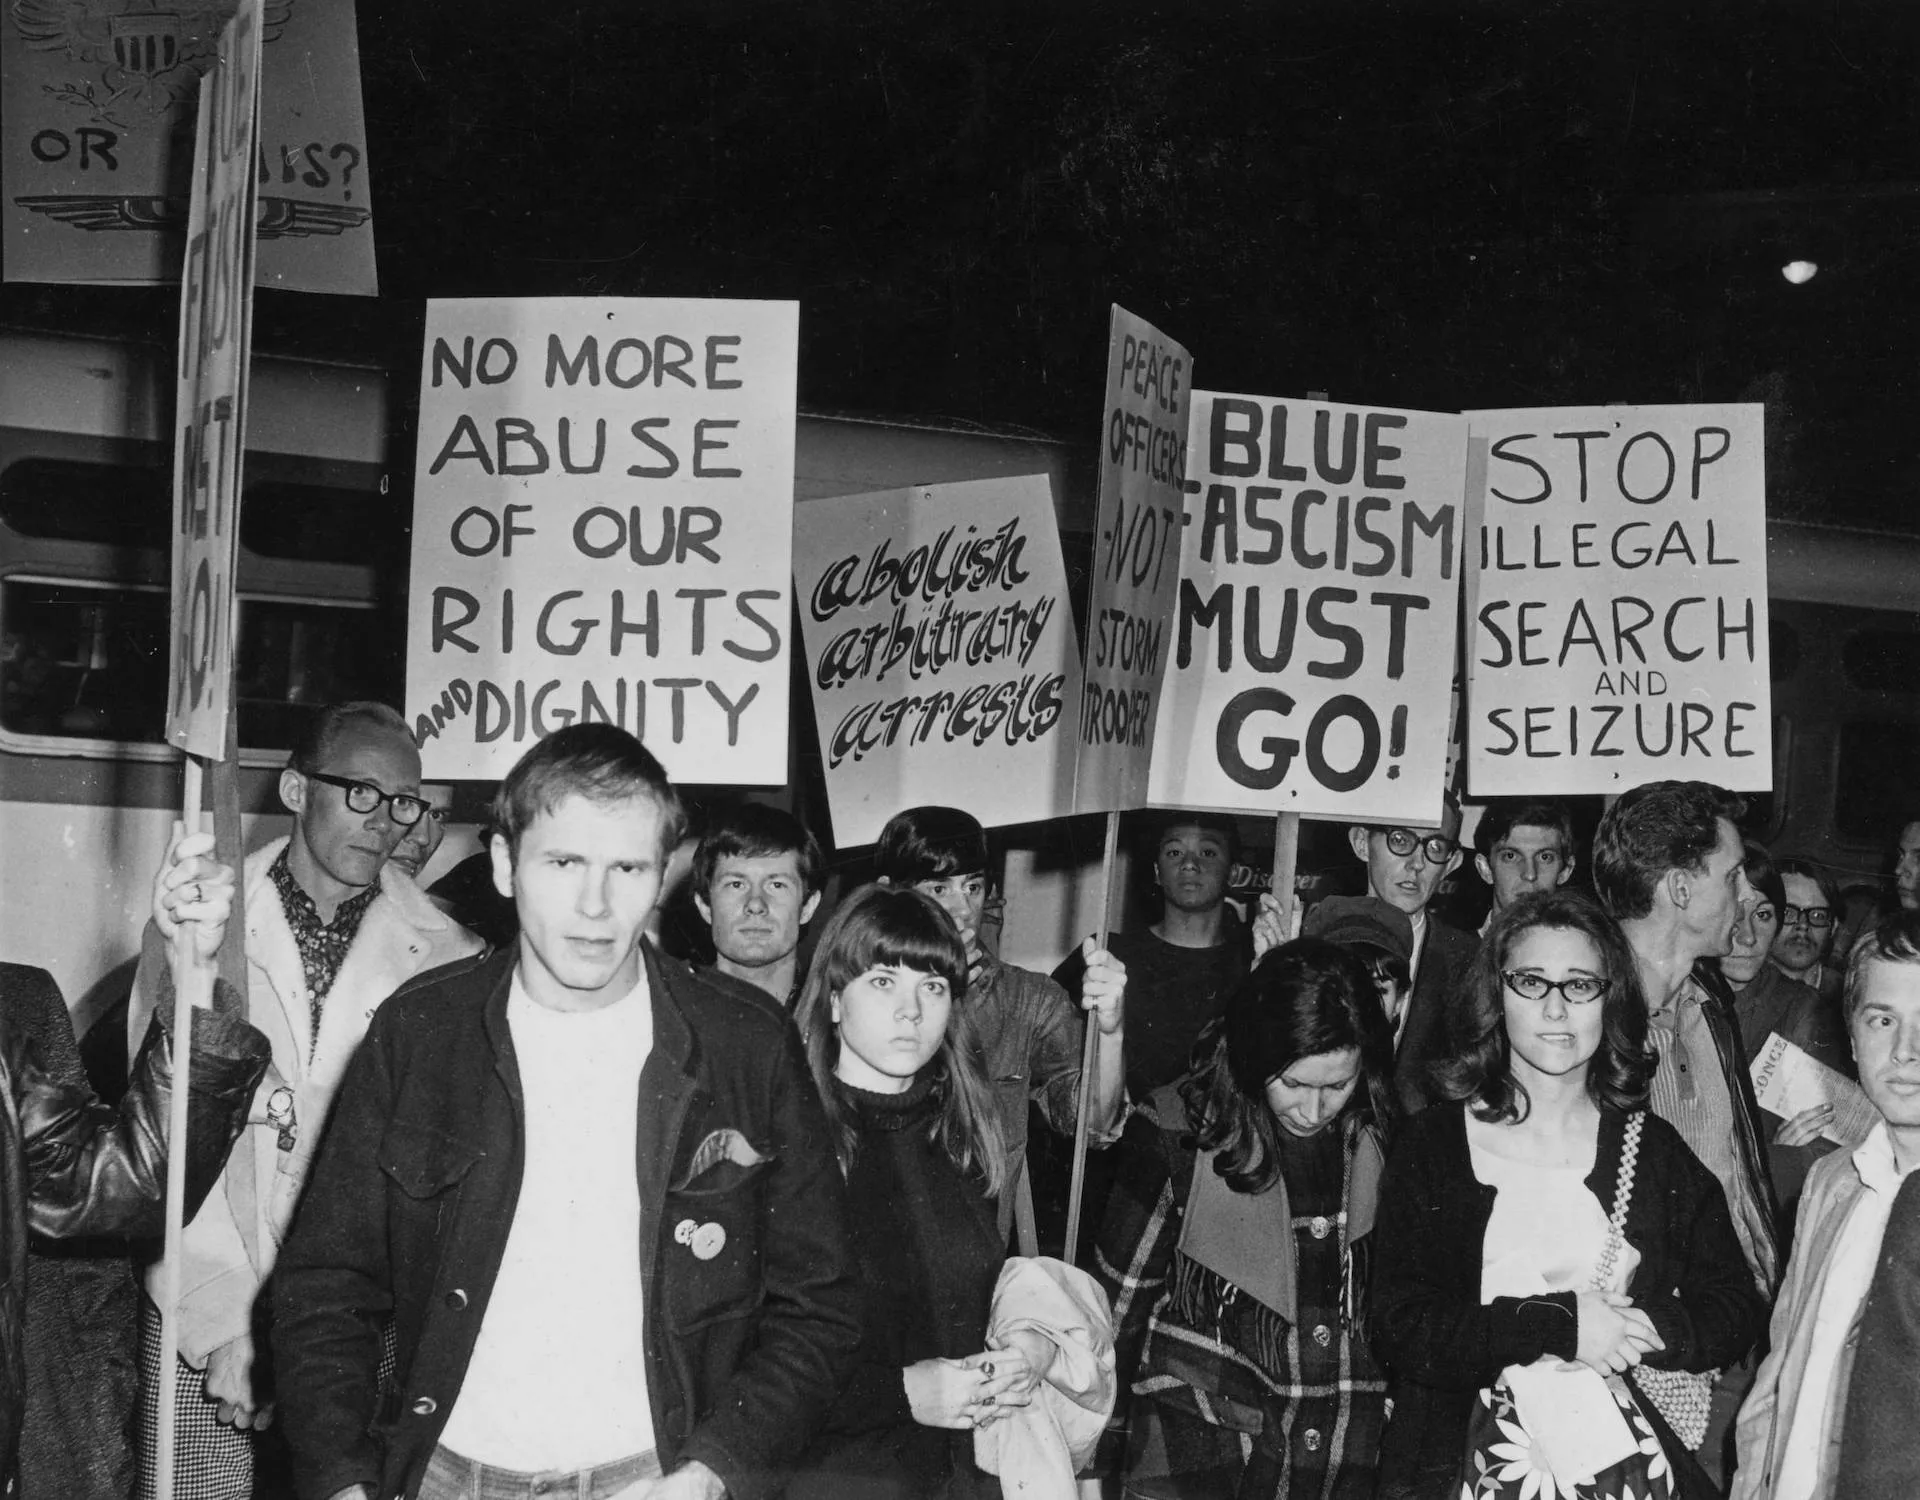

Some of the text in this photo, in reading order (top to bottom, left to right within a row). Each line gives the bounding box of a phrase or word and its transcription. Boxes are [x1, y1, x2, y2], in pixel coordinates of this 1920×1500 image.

[31, 127, 119, 171] OR
[431, 334, 743, 390] NO MORE
[1120, 333, 1182, 415] PEACE
[429, 414, 743, 479] ABUSE
[1110, 407, 1187, 491] OFFICERS
[1209, 396, 1408, 490] BLUE
[1490, 426, 1731, 504] STOP
[450, 503, 722, 567] OF OUR
[810, 516, 1030, 622] abolish
[1480, 518, 1740, 570] ILLEGAL
[431, 586, 781, 662] RIGHTS
[817, 595, 1056, 691] arbitrary
[1096, 609, 1162, 676] STORM
[1176, 577, 1430, 681] MUST
[1478, 596, 1755, 668] SEARCH
[416, 677, 760, 750] AND DIGNITY
[1083, 682, 1150, 749] TROOPER
[1595, 671, 1667, 696] AND
[829, 672, 1067, 770] arrests
[1216, 686, 1408, 793] GO!
[1485, 702, 1757, 758] SEIZURE
